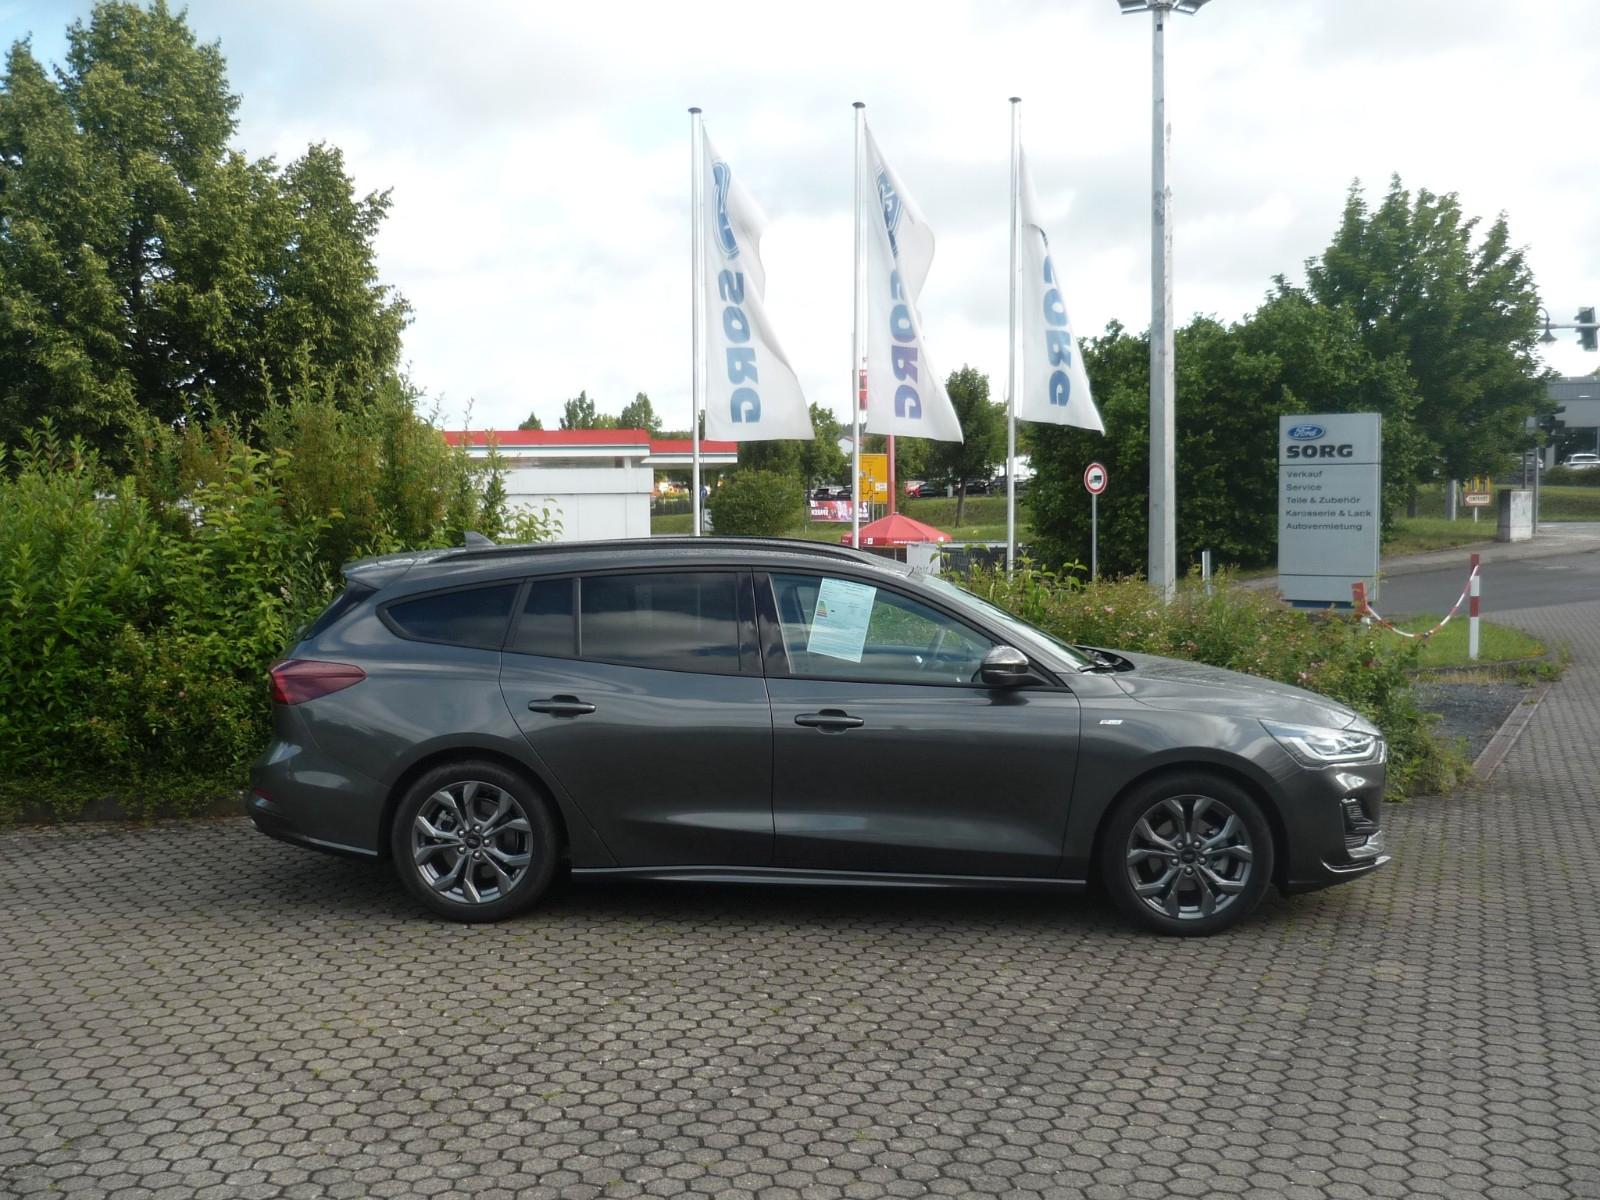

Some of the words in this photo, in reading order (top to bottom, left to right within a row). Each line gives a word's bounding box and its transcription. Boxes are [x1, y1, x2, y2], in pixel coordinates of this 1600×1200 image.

[1286, 444, 1353, 459] SORG
[1286, 470, 1323, 479] Verkauf
[1286, 483, 1322, 492] Service
[1286, 496, 1308, 504] Teile
[1318, 496, 1361, 504] Zubehör
[1286, 523, 1363, 532] Autovermietung
